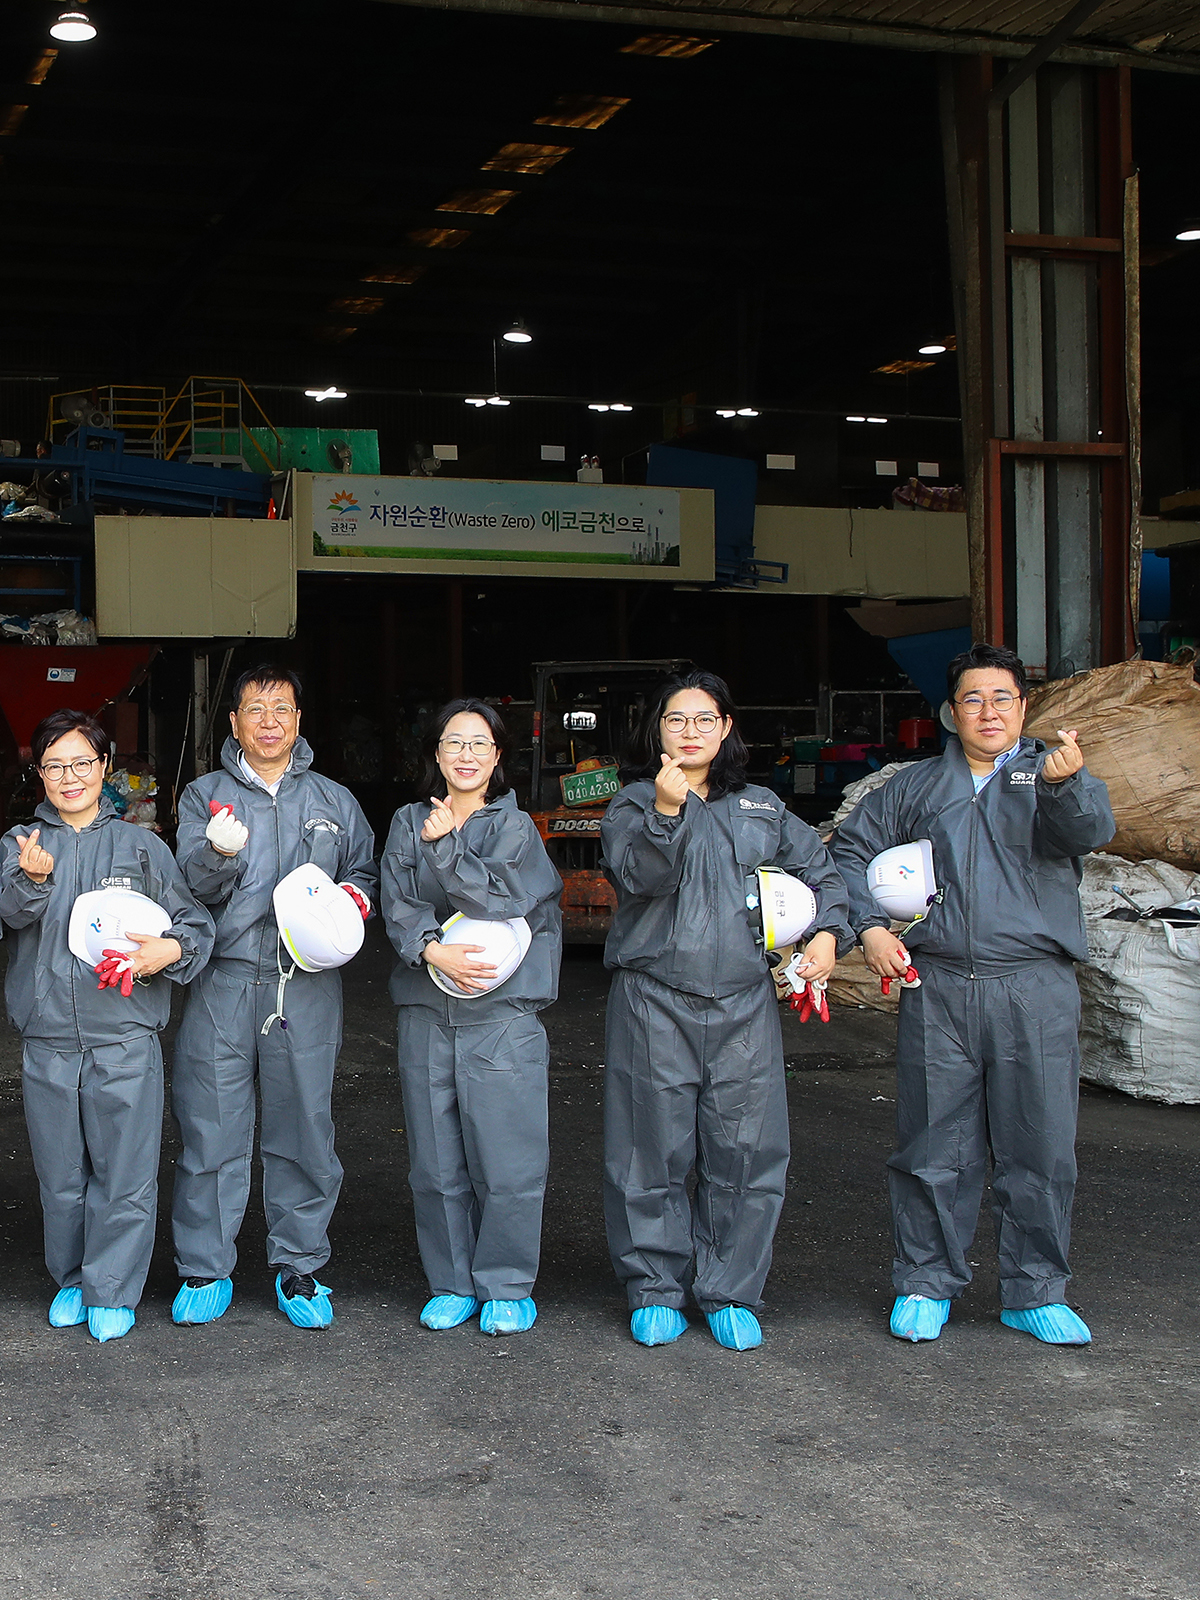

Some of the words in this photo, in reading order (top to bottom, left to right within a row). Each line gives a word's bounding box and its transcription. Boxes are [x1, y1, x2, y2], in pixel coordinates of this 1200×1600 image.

[330, 522, 357, 533] 금천구
[501, 514, 536, 531] Zero)
[541, 510, 646, 534] 에코금천으로
[553, 819, 601, 832] DOOS
